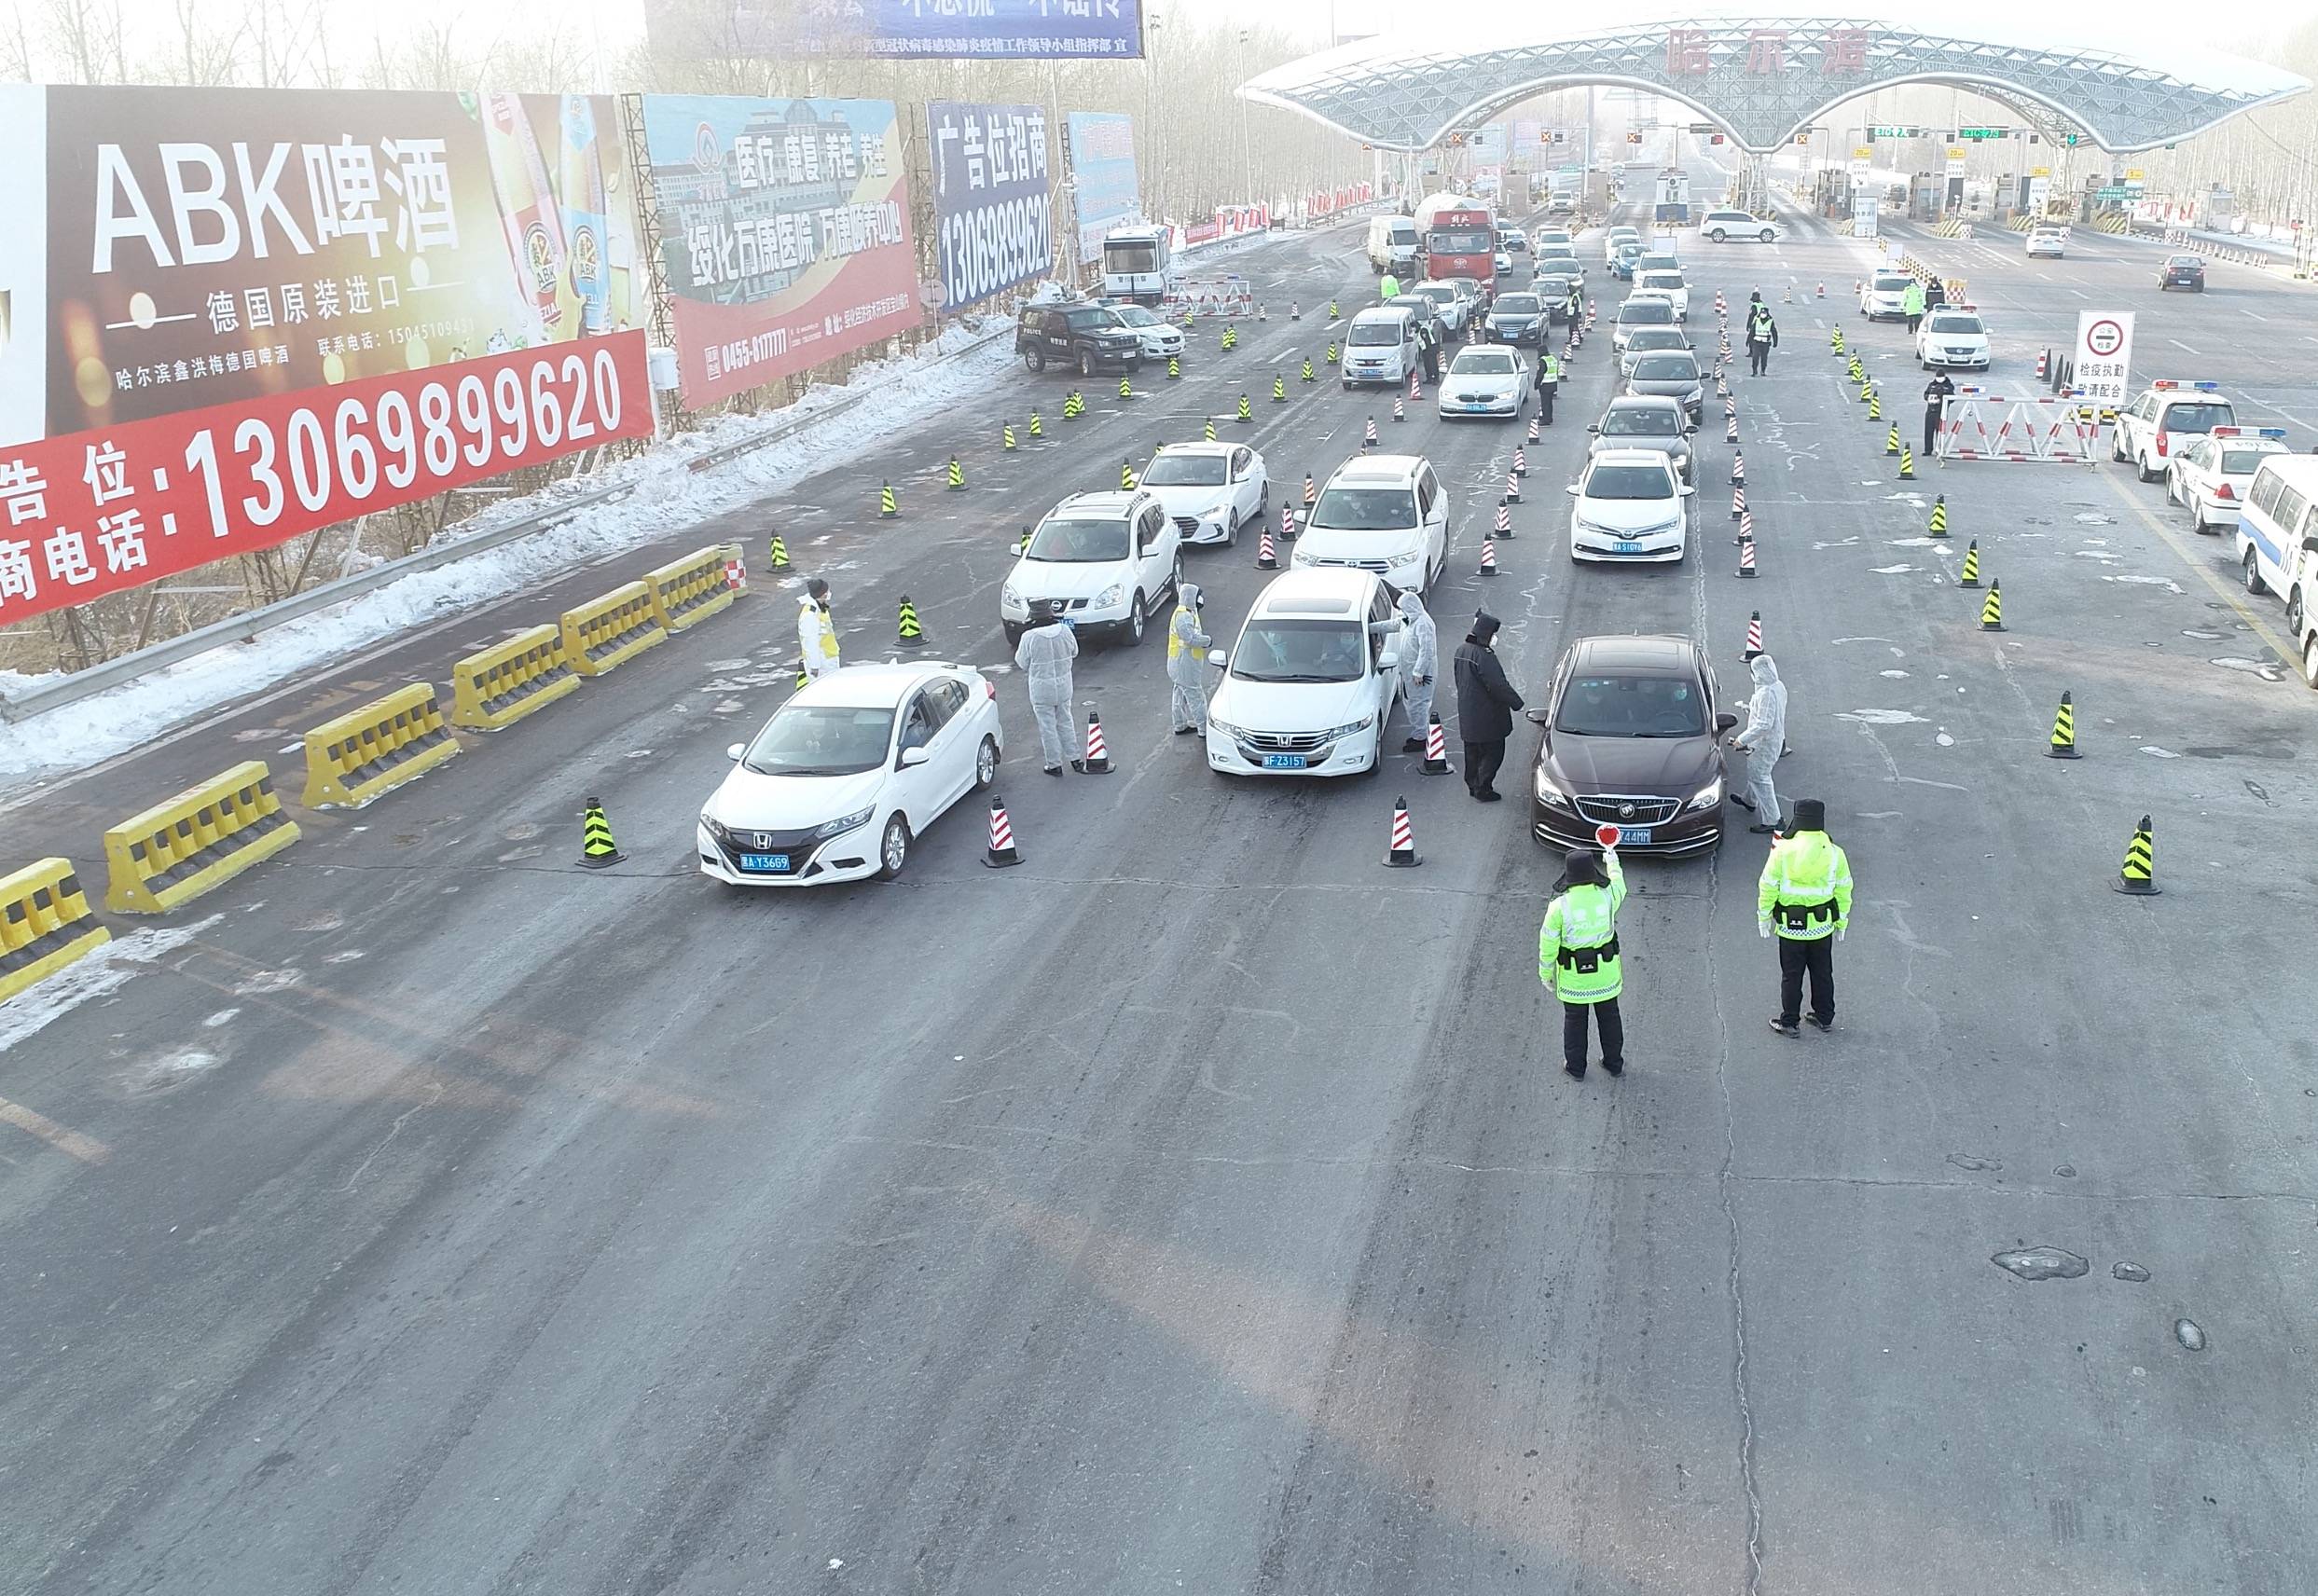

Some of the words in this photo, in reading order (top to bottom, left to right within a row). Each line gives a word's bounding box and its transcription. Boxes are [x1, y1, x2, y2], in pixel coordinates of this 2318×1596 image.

[735, 135, 775, 186] 医疗
[784, 133, 820, 182] 康复
[825, 133, 856, 178] 养老
[861, 133, 887, 177] 养生
[938, 112, 1047, 198] 广告位招商
[92, 133, 460, 273] ABK啤酒
[687, 212, 816, 286] 绥化万康医院
[942, 193, 1051, 307] 13069899620
[206, 275, 401, 335] 德国原装进口
[116, 344, 290, 391] 哈尔滨鑫洪梅德国啤酒
[2080, 362, 2124, 378] 检疫执勤
